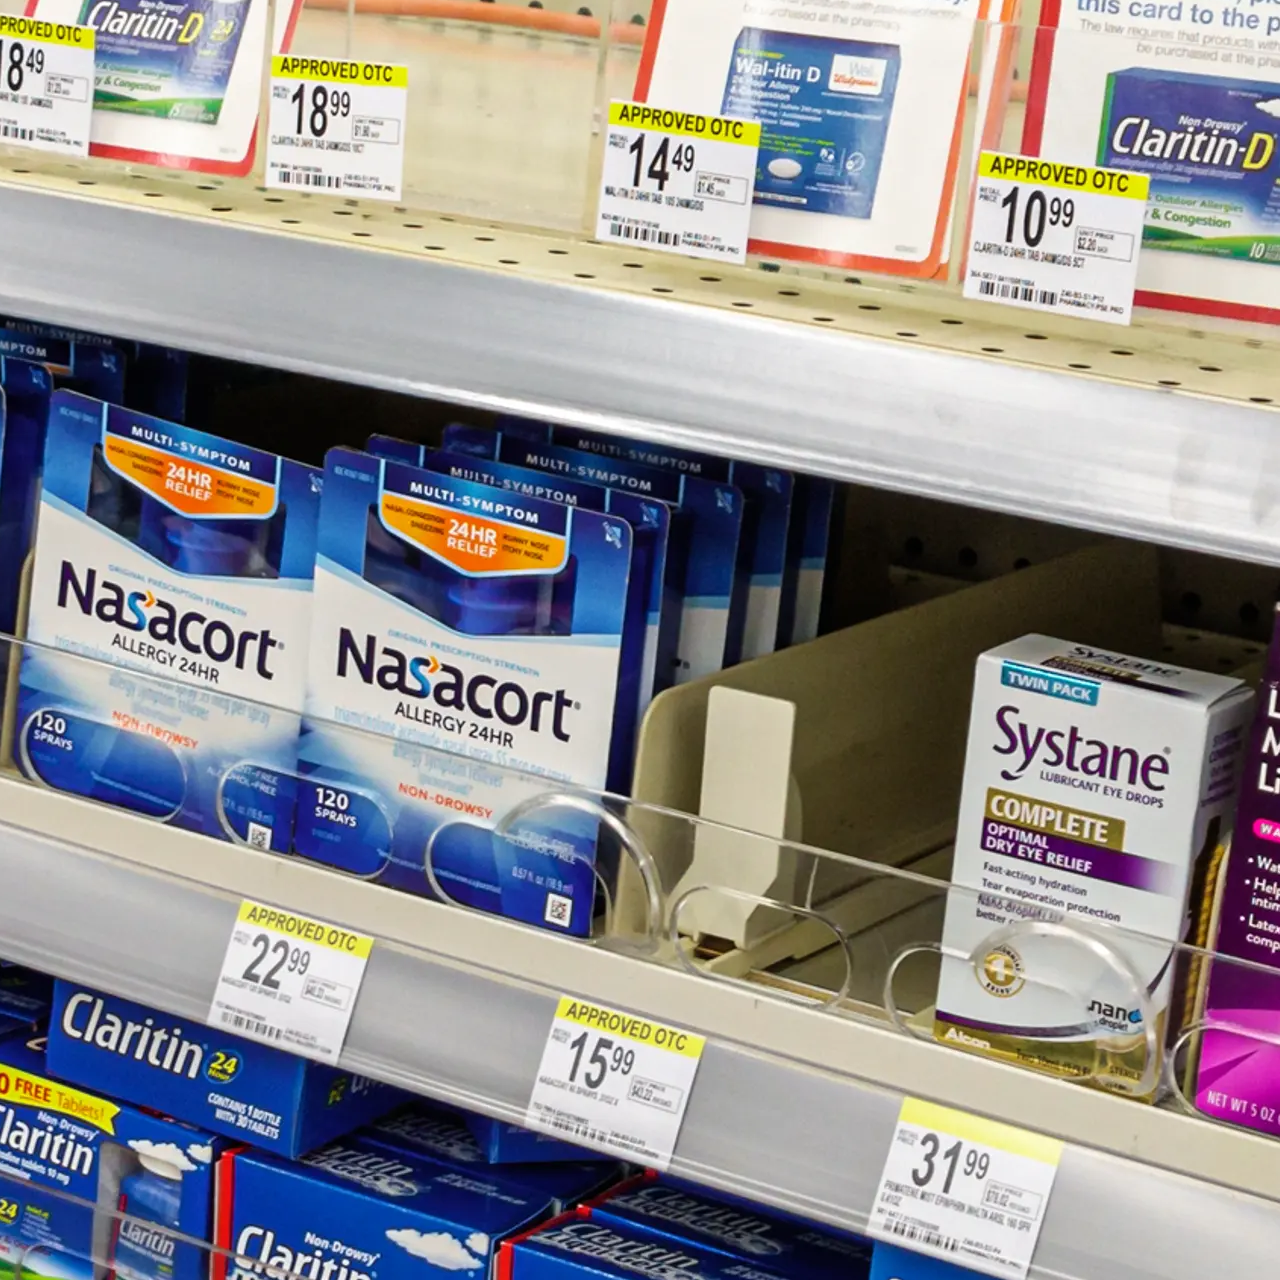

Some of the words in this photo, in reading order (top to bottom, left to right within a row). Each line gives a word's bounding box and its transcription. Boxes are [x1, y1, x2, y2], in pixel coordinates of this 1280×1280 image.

[87, 2, 204, 45] Claritin-D
[1190, 4, 1213, 25] to
[1221, 6, 1258, 29] the
[1112, 118, 1276, 170] Claritin-D
[990, 156, 1087, 187] APPROVED
[1093, 169, 1129, 193] OTC
[57, 560, 274, 680] Nasacort
[336, 628, 572, 741] Nasacort
[1009, 671, 1048, 693] TWIN
[1052, 682, 1091, 702] PACK
[993, 706, 1168, 791] Systane
[1040, 771, 1100, 793] LUBRICANT
[1104, 785, 1122, 798] EYE
[1125, 791, 1163, 808] DROPS
[987, 823, 1049, 849] OPTIMAL
[990, 796, 1108, 843] COMPLETE
[986, 837, 1015, 853] DRY
[1018, 844, 1043, 860] EYE
[1046, 850, 1092, 872] RELIEF
[247, 905, 324, 943] APPROVED
[327, 931, 356, 951] OTC
[62, 991, 203, 1080] Claritin
[15, 1078, 52, 1103] FREE
